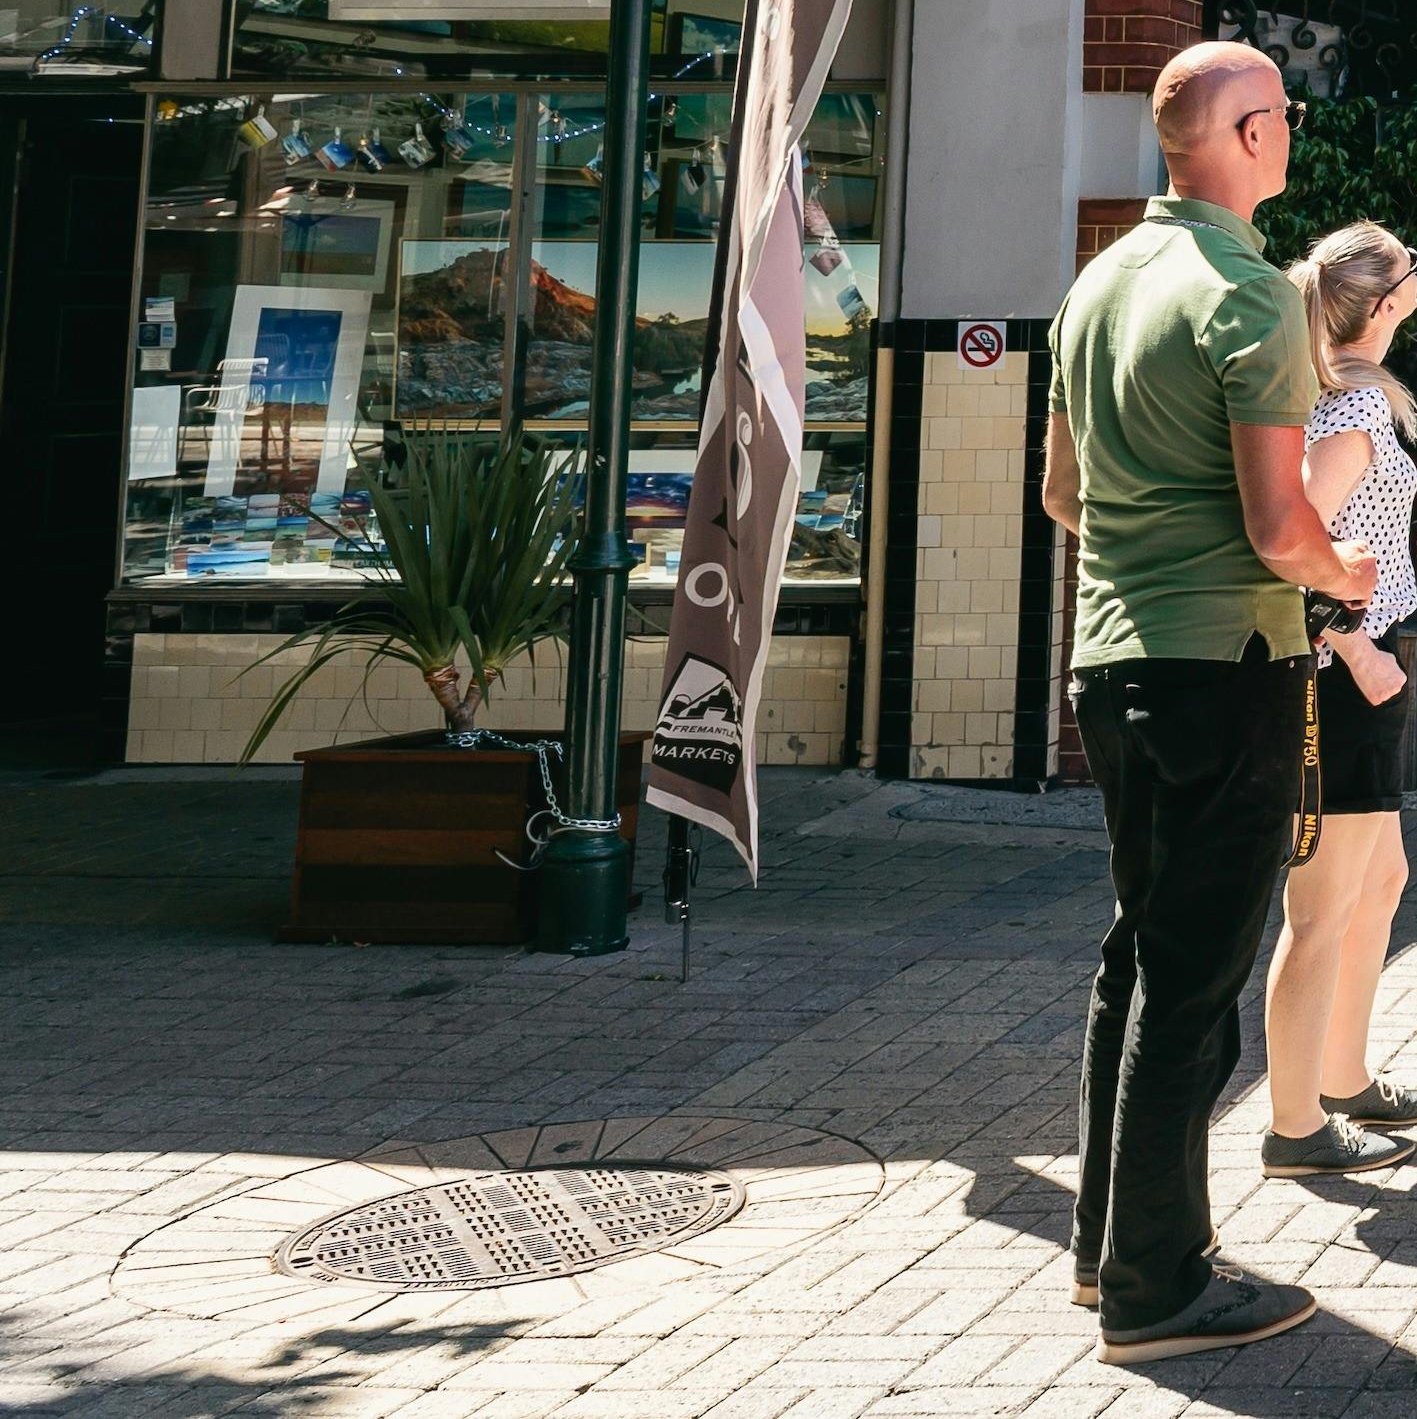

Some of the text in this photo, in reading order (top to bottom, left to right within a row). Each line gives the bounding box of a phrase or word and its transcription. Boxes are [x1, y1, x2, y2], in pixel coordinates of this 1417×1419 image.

[1305, 679, 1314, 722] Nikon
[672, 724, 737, 739] FREMANTLE
[1303, 723, 1319, 767] D750
[653, 743, 736, 766] MARKETS
